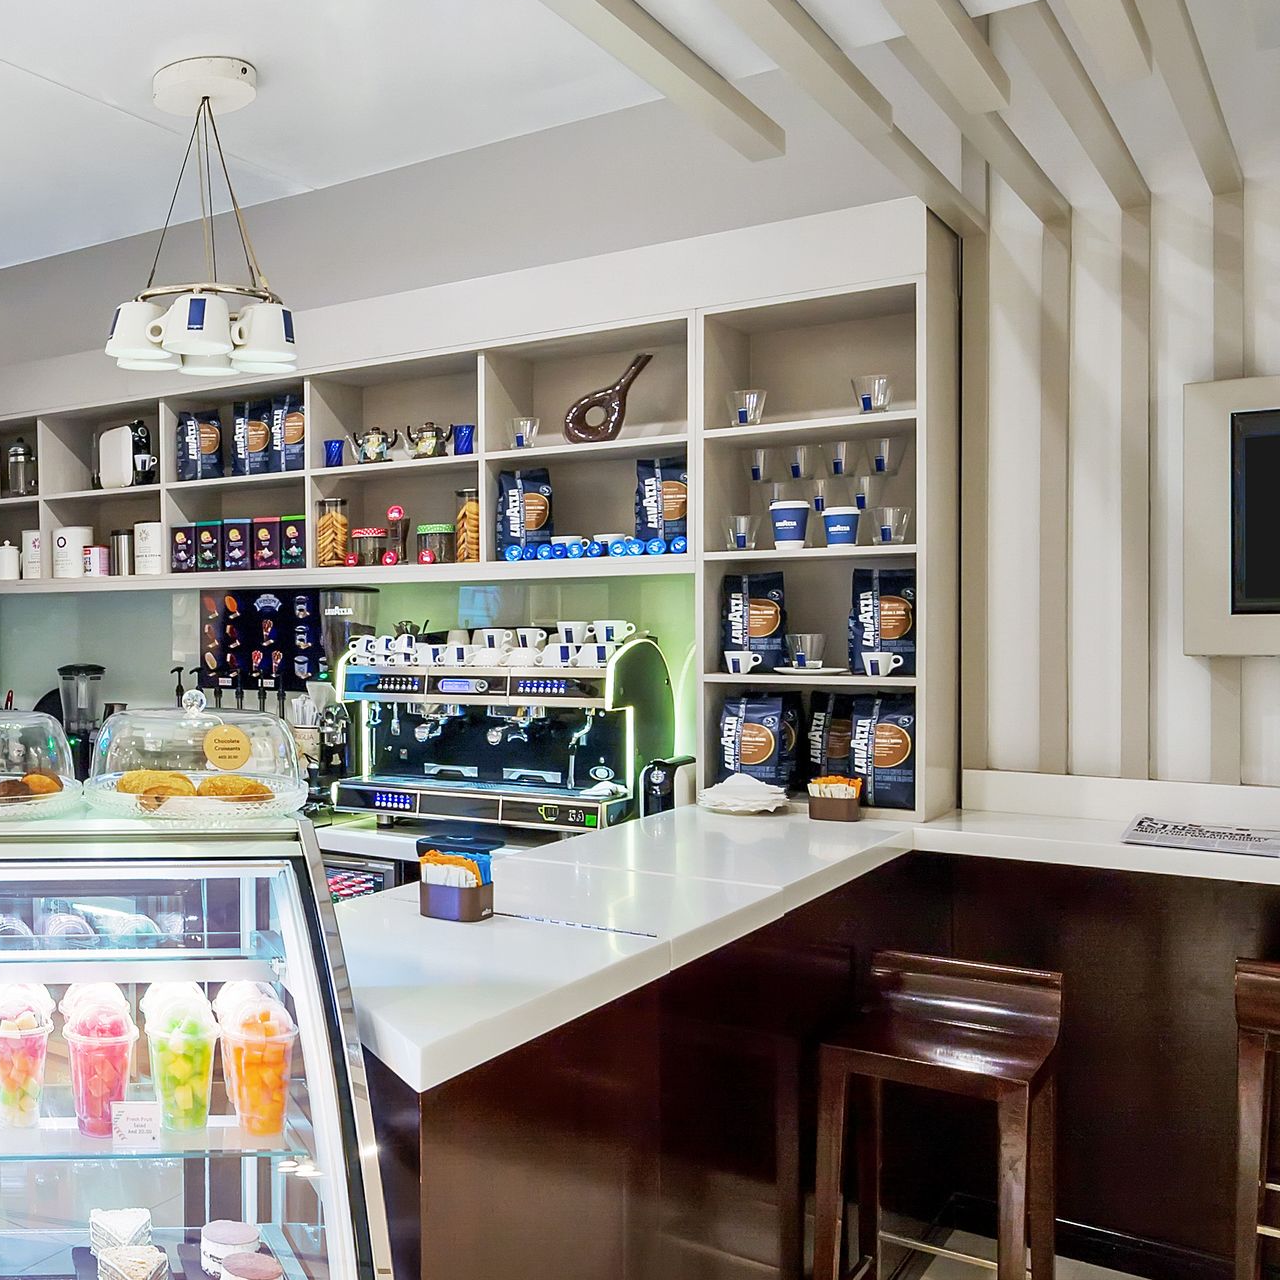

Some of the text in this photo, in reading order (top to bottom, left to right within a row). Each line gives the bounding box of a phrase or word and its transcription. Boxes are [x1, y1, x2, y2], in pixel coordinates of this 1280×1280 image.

[185, 420, 198, 460] LAVAZZA
[234, 418, 245, 459] LAVAZZA
[272, 410, 283, 451] LAVAZZA
[506, 489, 521, 537] LAVAZZA
[642, 477, 658, 529] LAVAZZA
[728, 593, 743, 644] LAVAZZA
[858, 591, 874, 647] LAVAZZA
[721, 716, 738, 771] LAVAZZA
[808, 712, 826, 764] LAVAZZA
[850, 719, 871, 774] LAVAZZA
